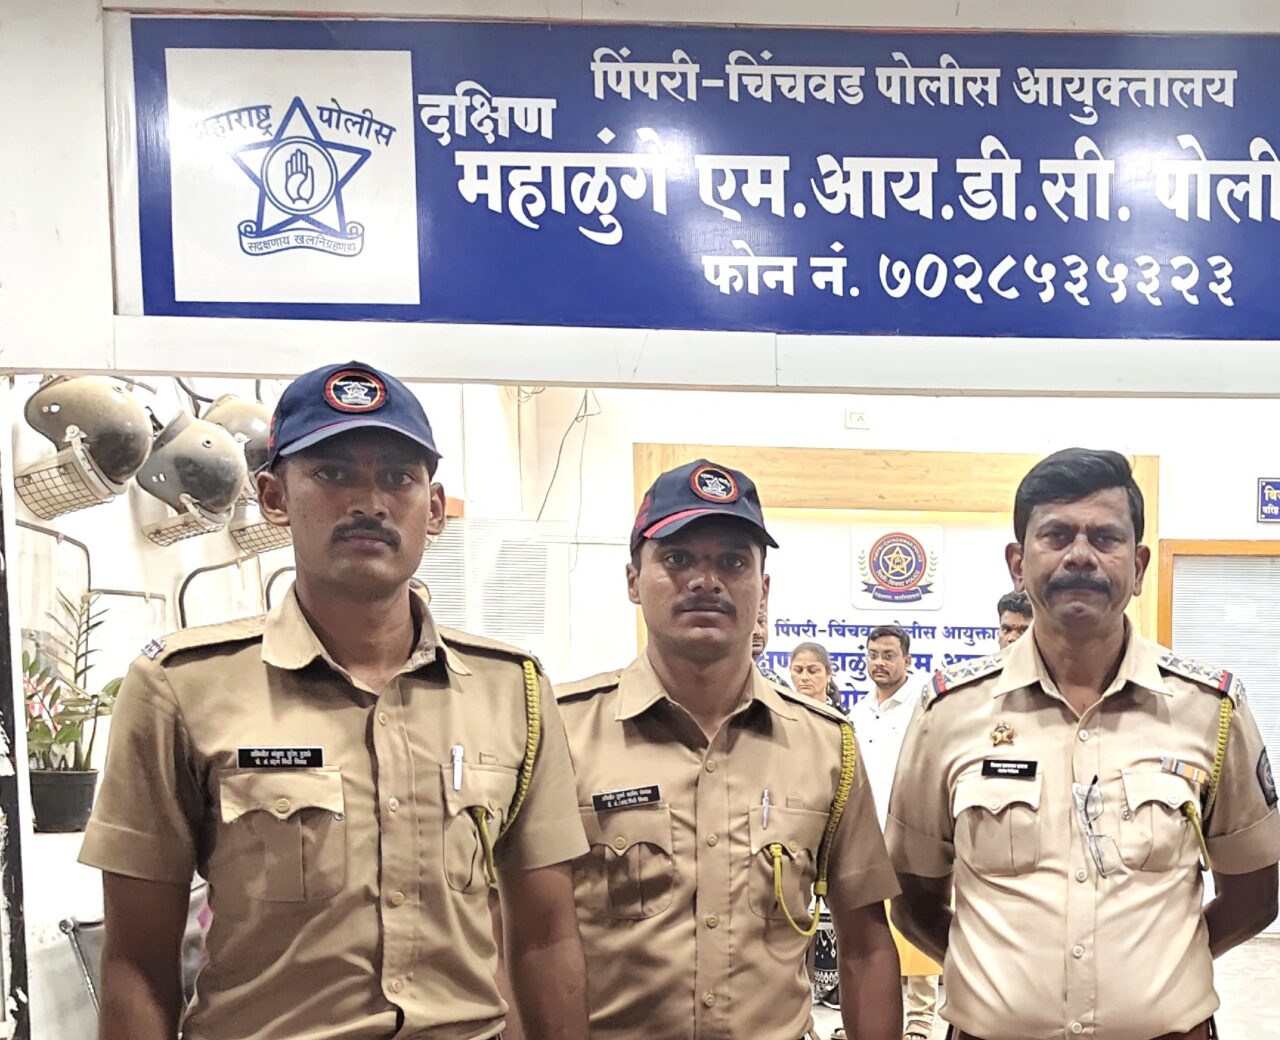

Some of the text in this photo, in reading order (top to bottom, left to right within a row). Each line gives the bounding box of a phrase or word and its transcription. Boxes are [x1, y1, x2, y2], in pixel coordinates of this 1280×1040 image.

[418, 80, 556, 146] दक्षिण
[591, 47, 1237, 125] पिंपरी-चिंचवड पोलीस आयुक्तालय
[316, 97, 397, 147] पोलीस
[455, 127, 668, 245] महाळुंगे
[702, 240, 1235, 308] फोन नं. ७०२८५३५३२३
[775, 619, 873, 639] पिंपरी-चिंचव
